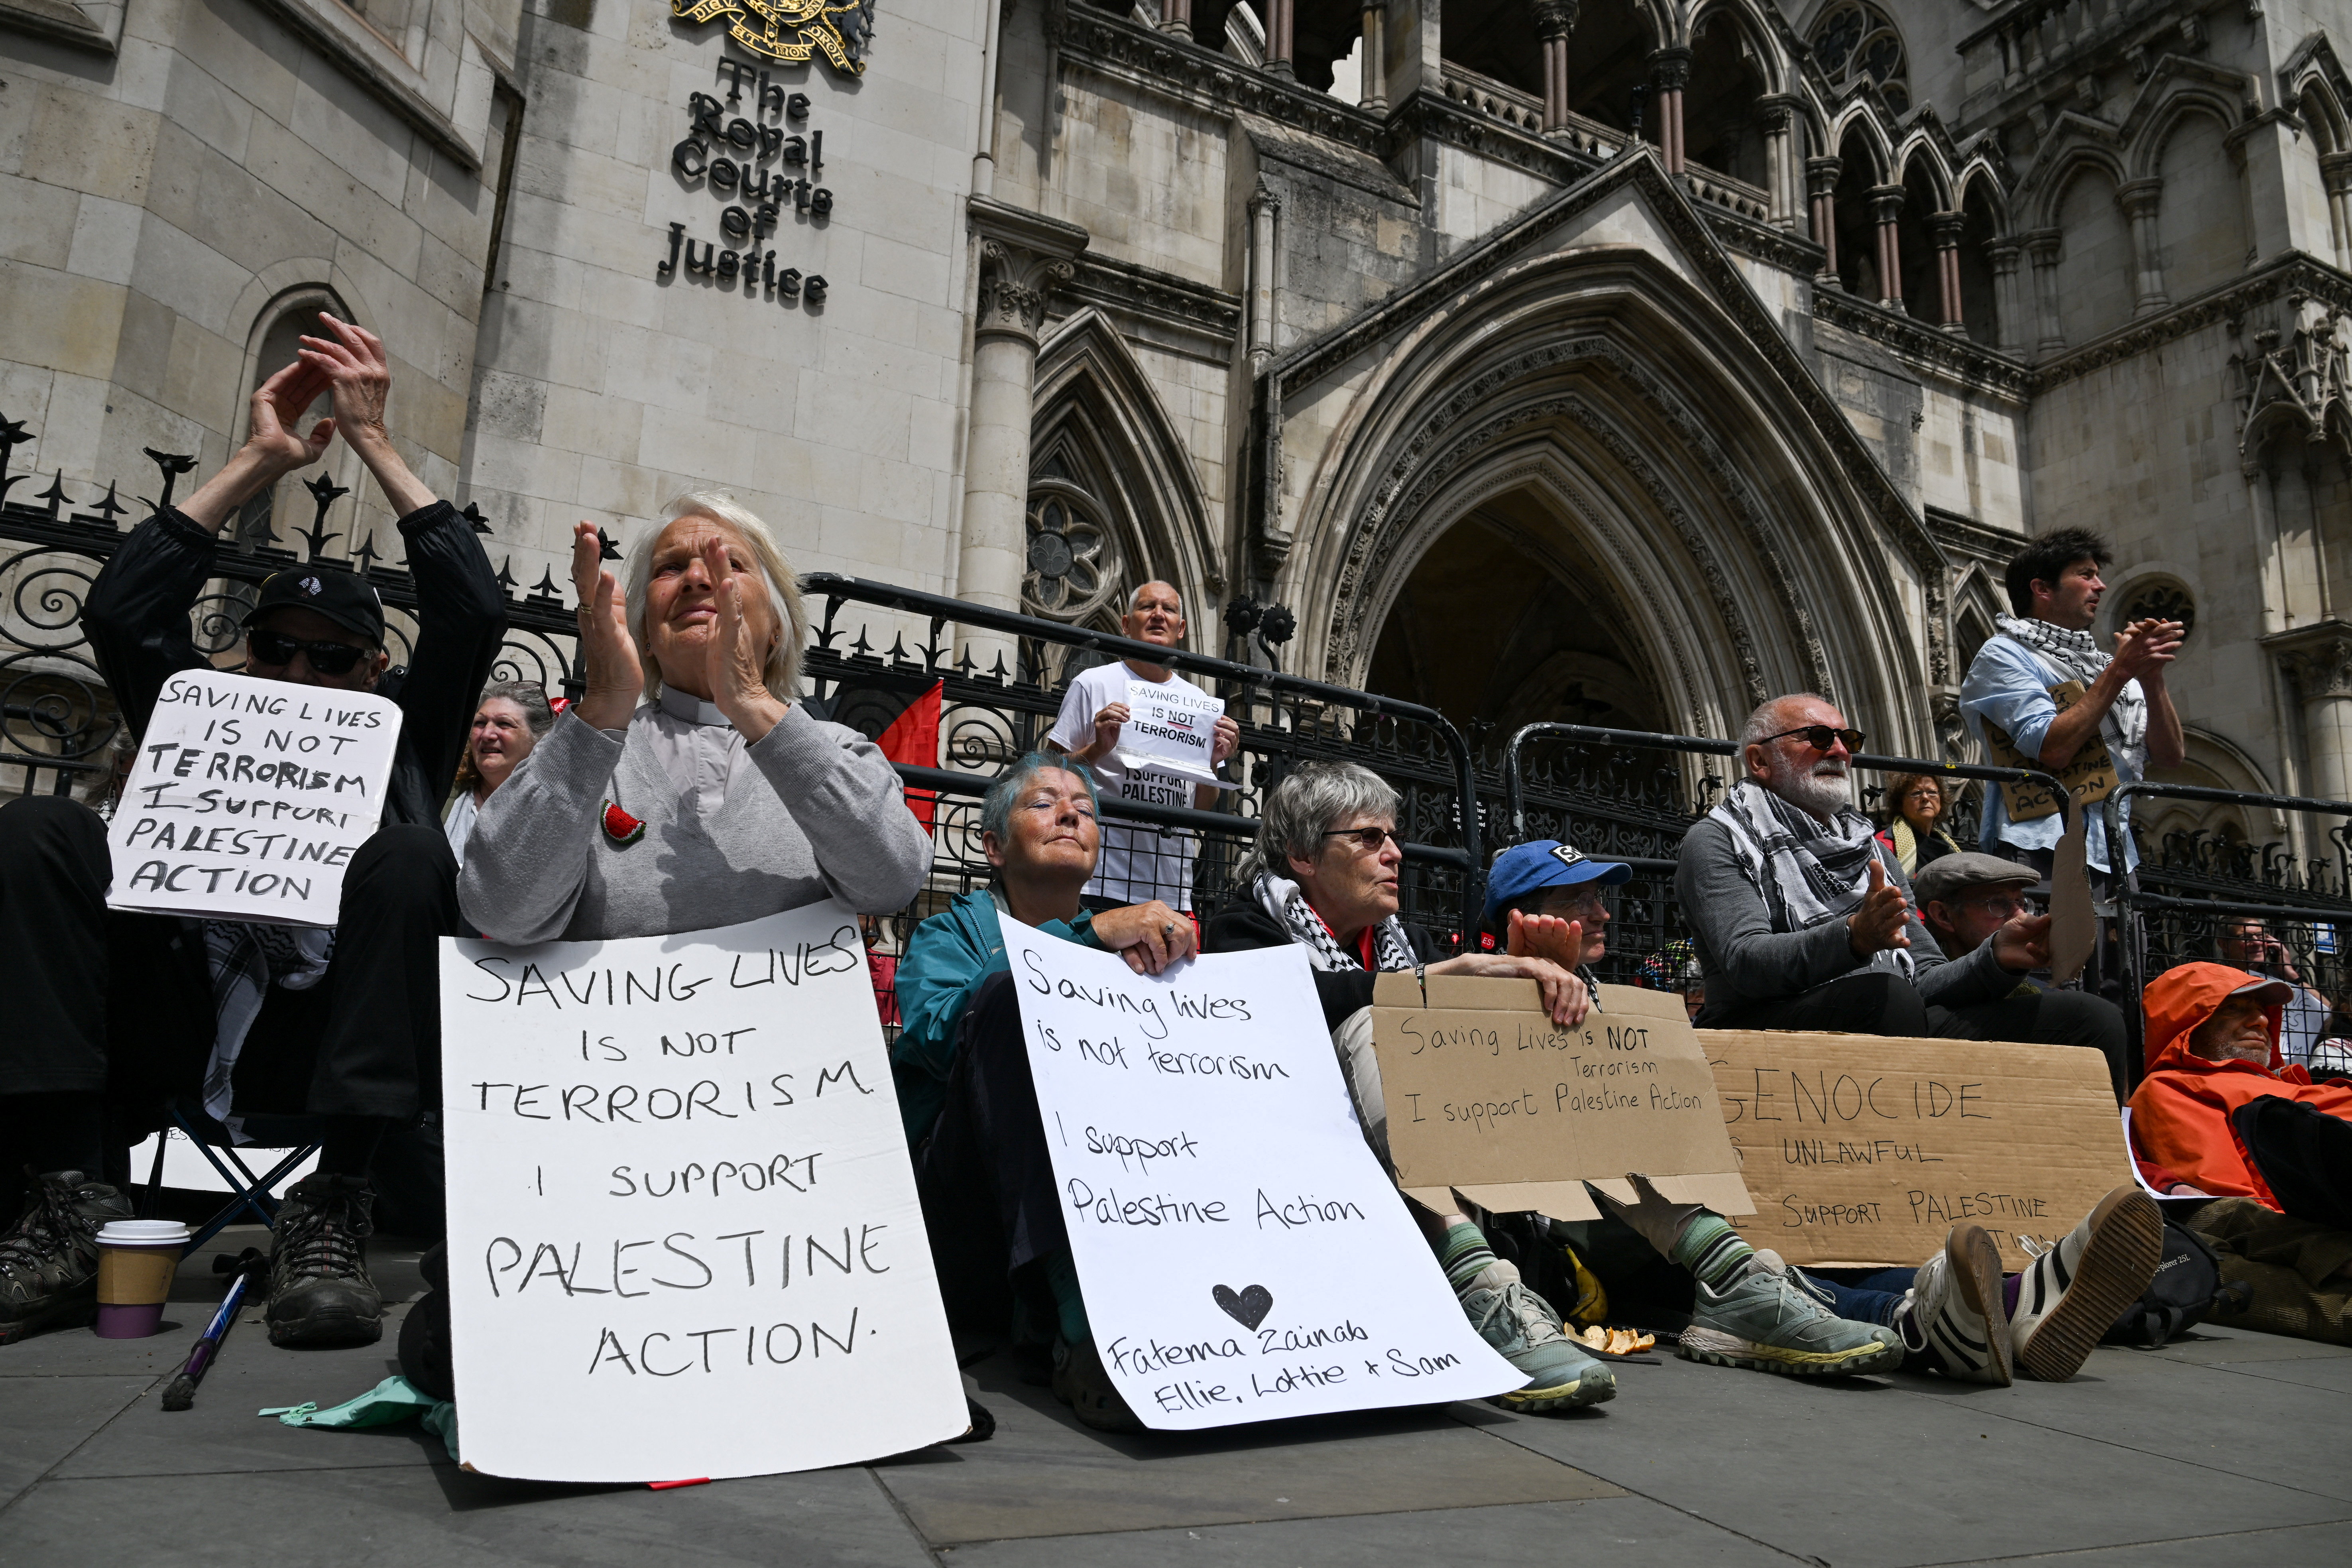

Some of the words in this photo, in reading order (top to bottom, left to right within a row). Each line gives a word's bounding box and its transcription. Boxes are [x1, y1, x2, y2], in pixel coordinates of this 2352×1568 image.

[808, 26, 848, 68] DROIT
[719, 55, 811, 119] The
[690, 91, 824, 169] Royal
[673, 137, 833, 215] Courts
[721, 203, 780, 240] of
[658, 221, 829, 301] Justice
[159, 680, 288, 715] SAVING
[299, 703, 381, 728] LIVES
[1130, 686, 1180, 704] SAVING
[1183, 697, 1219, 713] LIVES
[1152, 707, 1164, 718] IS
[1168, 710, 1196, 725] NOT
[204, 719, 242, 745] IS
[264, 730, 358, 755] NOT
[1134, 720, 1206, 748] TERRORISM
[148, 743, 366, 798] TERRORISM
[2016, 776, 2104, 812] ACON
[140, 781, 193, 809] I
[195, 789, 360, 829] SUPPORT
[126, 818, 358, 867] PALESTINE
[130, 860, 312, 901] ACTION
[466, 957, 714, 1009] SAVING
[730, 925, 859, 988] LIVES
[1023, 948, 1169, 1039] Saving
[582, 1030, 628, 1061] IS
[662, 1027, 757, 1057] NOT
[1037, 1019, 1062, 1053] is
[1079, 1036, 1129, 1070] not
[1148, 1041, 1291, 1081] terrorism
[1400, 1016, 1500, 1056] Saving
[1518, 1022, 1568, 1051] Lives
[1579, 1028, 1593, 1047] is
[1607, 1026, 1648, 1051] NOT
[1570, 1056, 1658, 1078] Terrorism
[472, 1060, 874, 1123] TERRORISM
[1405, 1093, 1426, 1123] I
[1443, 1088, 1538, 1134] support
[1555, 1082, 1640, 1114] Palestine
[1650, 1083, 1702, 1111] Action
[609, 1152, 822, 1197] SUPPORT
[1085, 1126, 1198, 1176] support
[1784, 1138, 1943, 1165] UNLAWFUL
[1068, 1177, 1231, 1226] Palestine
[1257, 1188, 1366, 1231] Action
[1783, 1194, 1881, 1228] SUPPORT
[1908, 1190, 2049, 1224] PALESTINE
[486, 1224, 890, 1298] PALESTINE
[2177, 1254, 2191, 1264] 25L
[589, 1306, 877, 1377] ACTION.
[1107, 1336, 1246, 1380] Fatema
[1257, 1318, 1369, 1354] Zainab
[1253, 1360, 1348, 1398] Lottie
[1386, 1348, 1462, 1377] Sam
